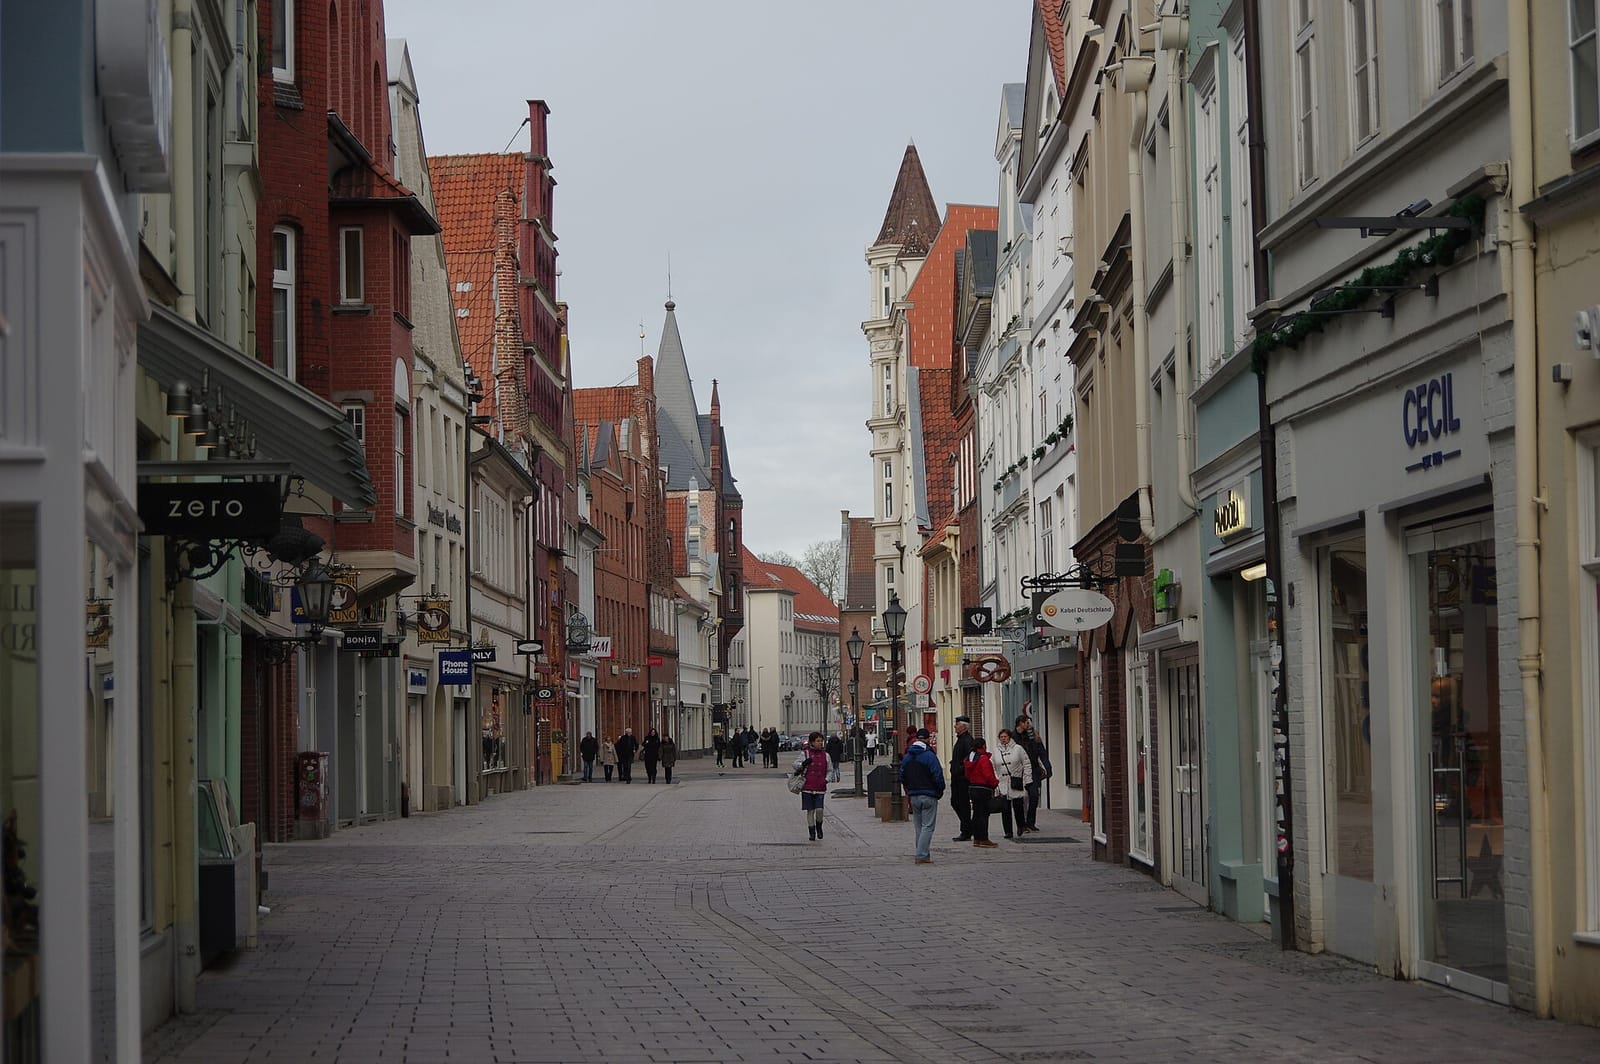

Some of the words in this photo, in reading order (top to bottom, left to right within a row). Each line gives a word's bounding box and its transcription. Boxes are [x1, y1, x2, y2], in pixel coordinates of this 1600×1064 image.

[1403, 373, 1460, 448] CECIL
[168, 500, 243, 517] zero
[328, 610, 357, 621] AUNO
[346, 635, 377, 646] BONITA
[420, 631, 449, 640] RAUNO
[473, 651, 492, 660] NLY
